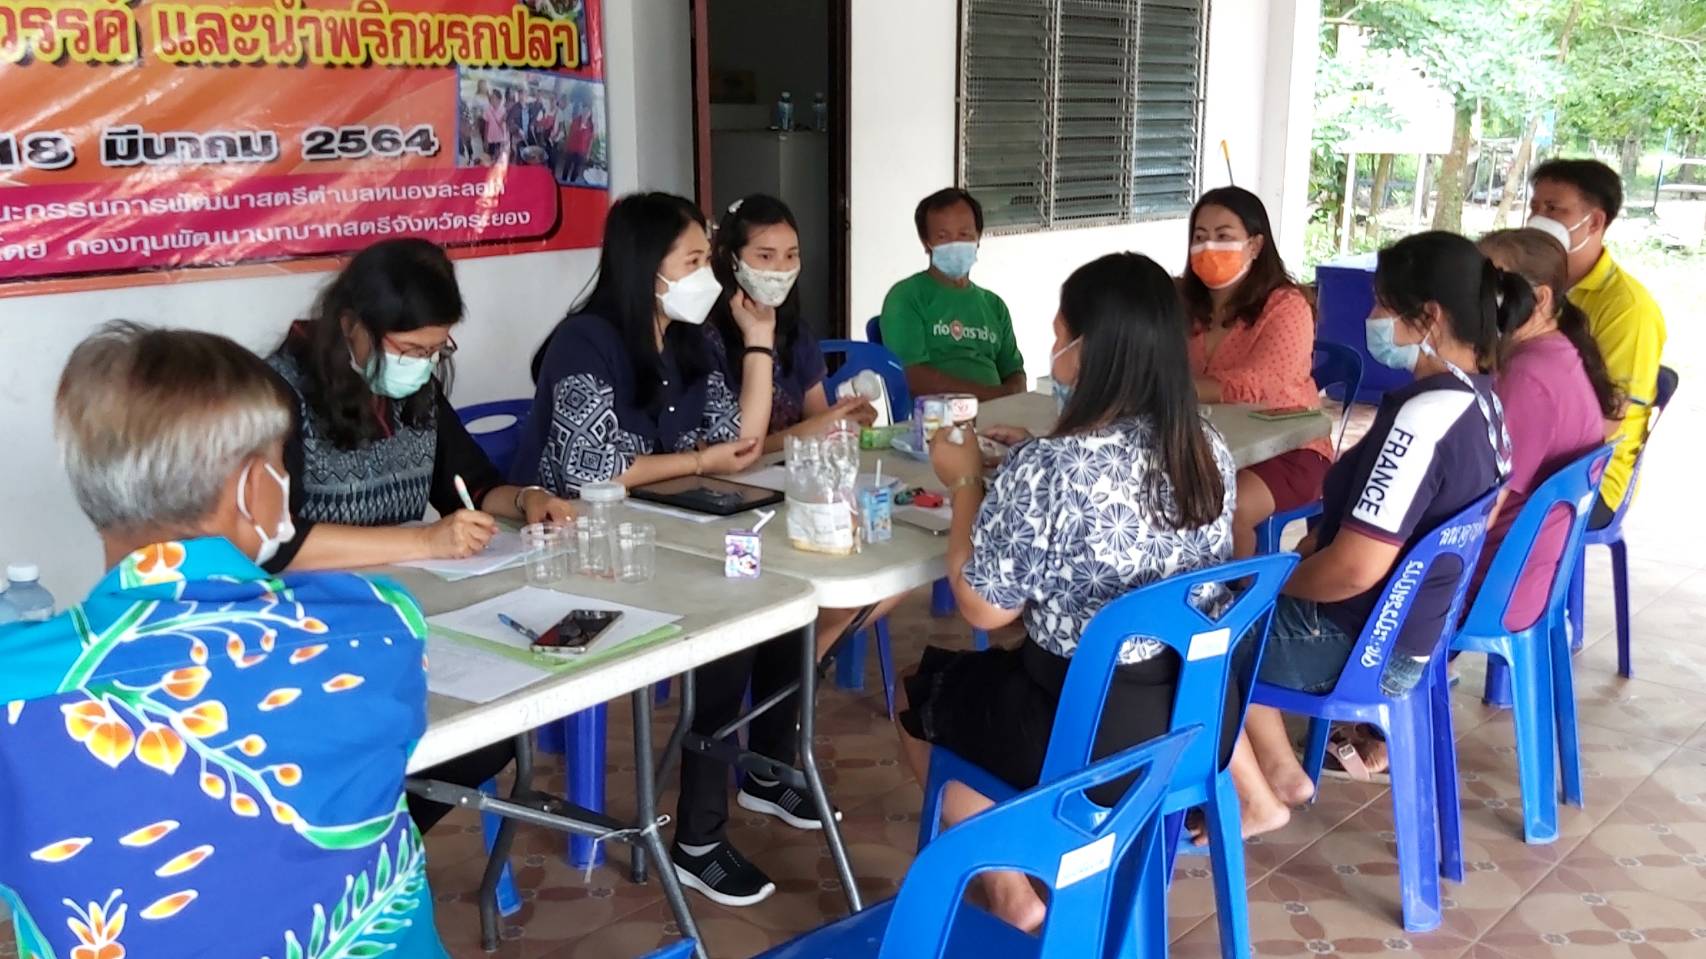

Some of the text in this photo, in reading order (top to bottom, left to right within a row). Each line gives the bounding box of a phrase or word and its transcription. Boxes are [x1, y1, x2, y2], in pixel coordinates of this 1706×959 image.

[156, 0, 579, 67] และนำพริกนรกปลา
[102, 124, 279, 166] มีนาคม
[302, 125, 439, 160] 2564
[1358, 426, 1414, 517] FRANCE
